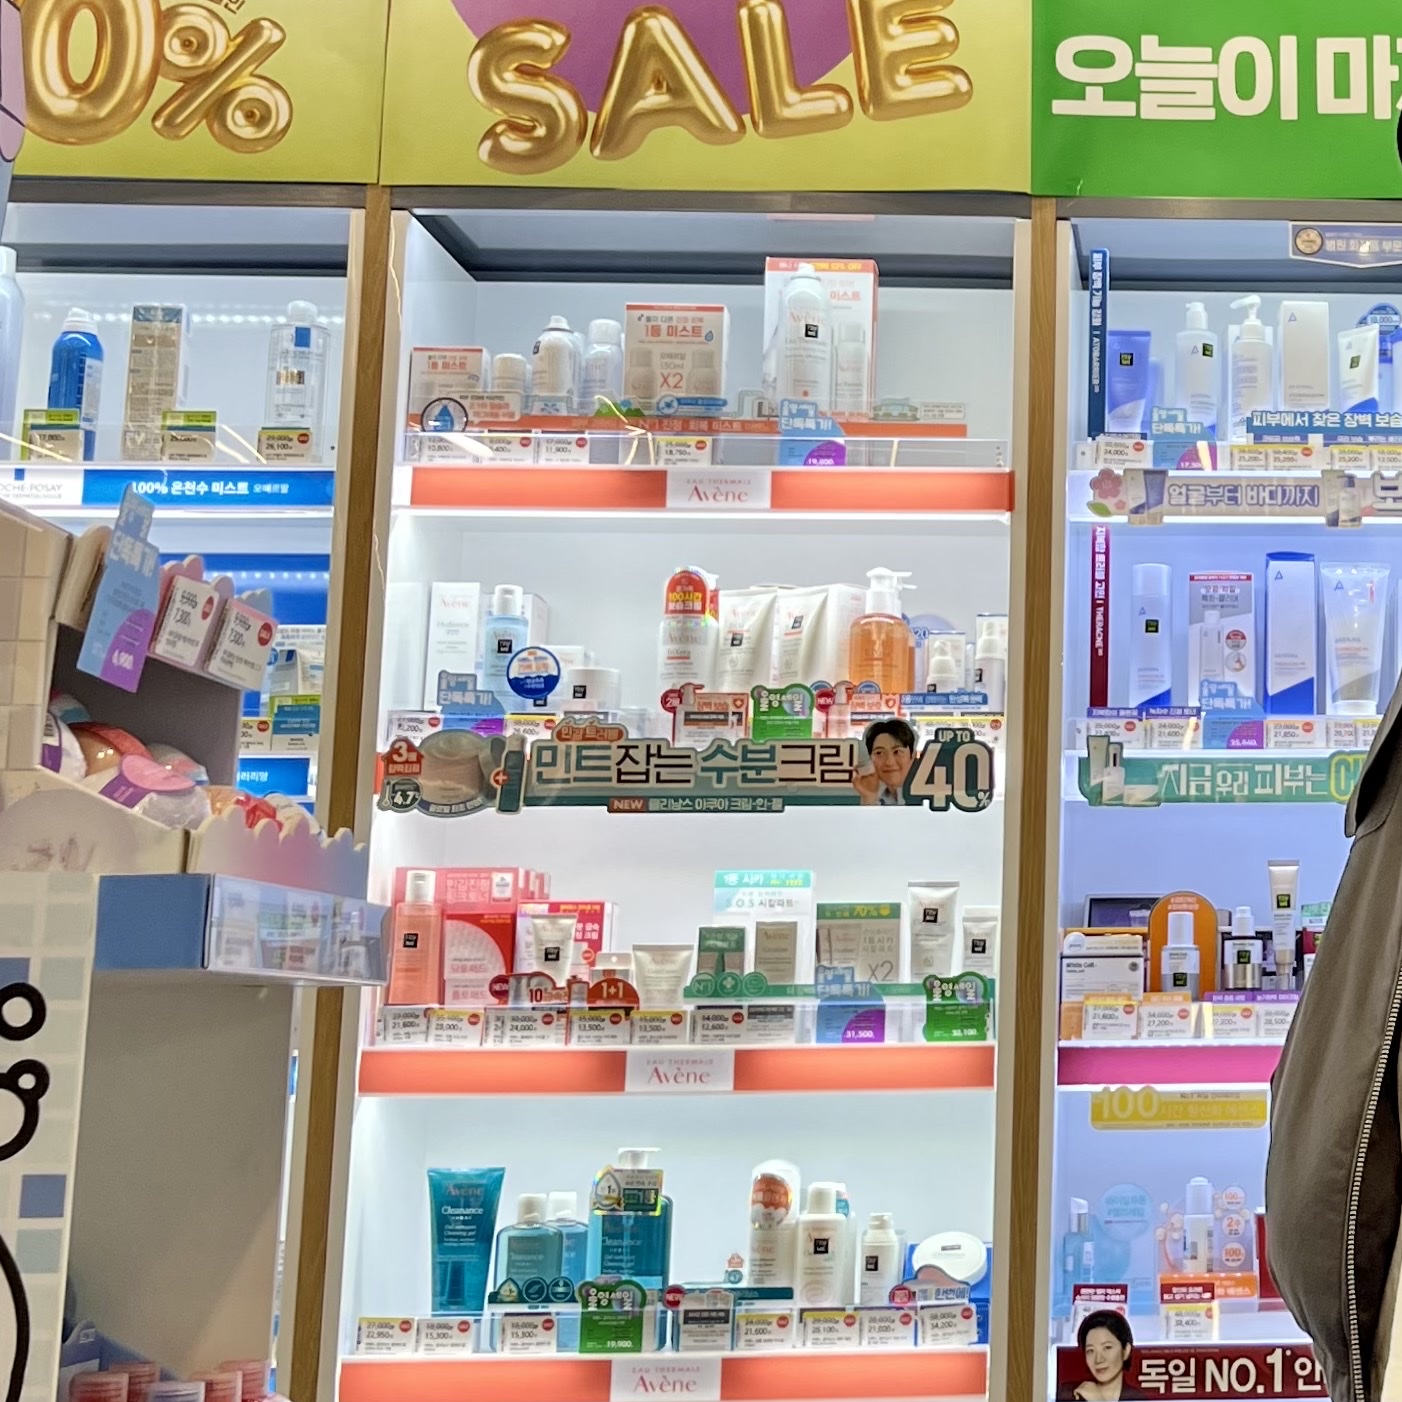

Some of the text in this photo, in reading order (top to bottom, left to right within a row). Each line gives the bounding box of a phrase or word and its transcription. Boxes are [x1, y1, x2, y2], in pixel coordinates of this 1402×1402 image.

[1051, 34, 1299, 120] 오늘이
[468, 0, 973, 175] SALE
[659, 372, 684, 390] X2
[1251, 411, 1309, 428] 피부에서
[1313, 412, 1341, 428] 찾은
[1344, 412, 1374, 428] 장벽
[171, 479, 209, 496] 온천수
[212, 480, 249, 495] 미스트
[688, 484, 748, 504] Avène
[1168, 483, 1320, 508] 얼굴부터 바디까지
[1253, 762, 1330, 796] 피부는
[612, 799, 644, 810] NEW
[649, 1066, 711, 1085] Avène
[633, 1374, 698, 1394] Avène
[1138, 1357, 1196, 1394] 독일
